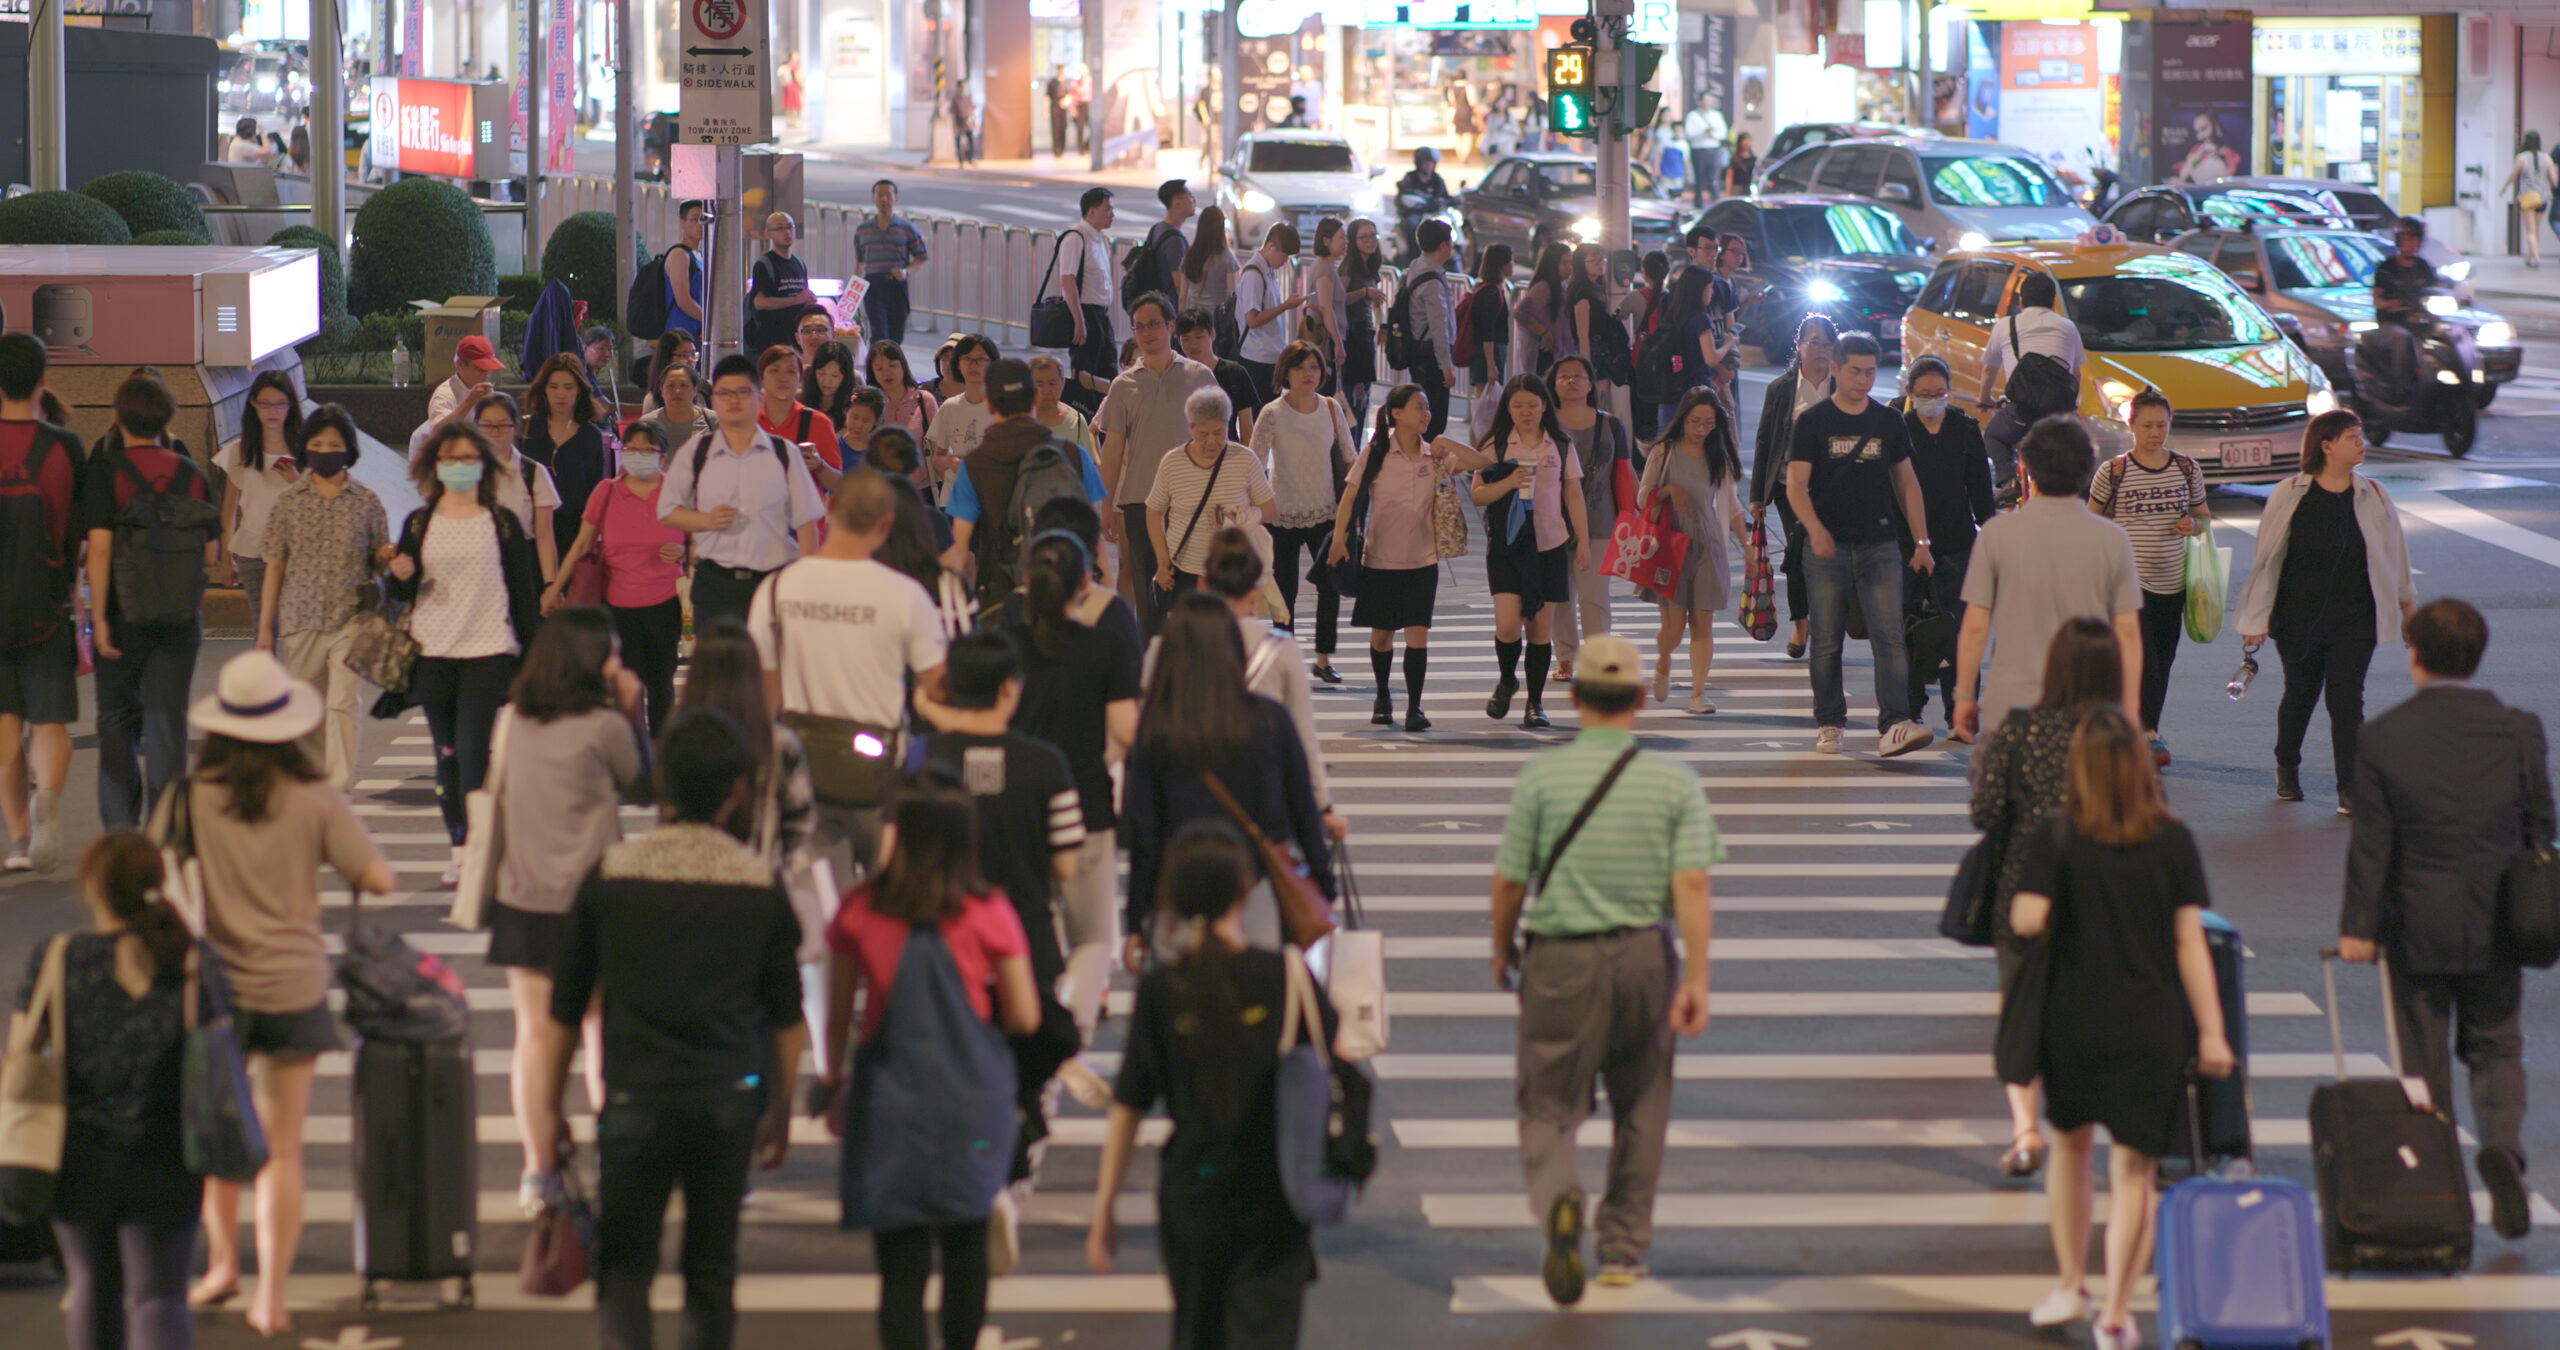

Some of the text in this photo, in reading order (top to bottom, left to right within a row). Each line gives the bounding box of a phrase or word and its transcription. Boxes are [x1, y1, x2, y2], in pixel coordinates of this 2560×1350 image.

[704, 0, 735, 28] 停
[2185, 34, 2221, 48] acer
[1554, 54, 1583, 84] 29
[696, 79, 755, 88] SIDEWALK
[688, 126, 752, 135] TOW-AWAY ZONE
[721, 135, 739, 143] 110
[780, 599, 877, 625] FINISHER
